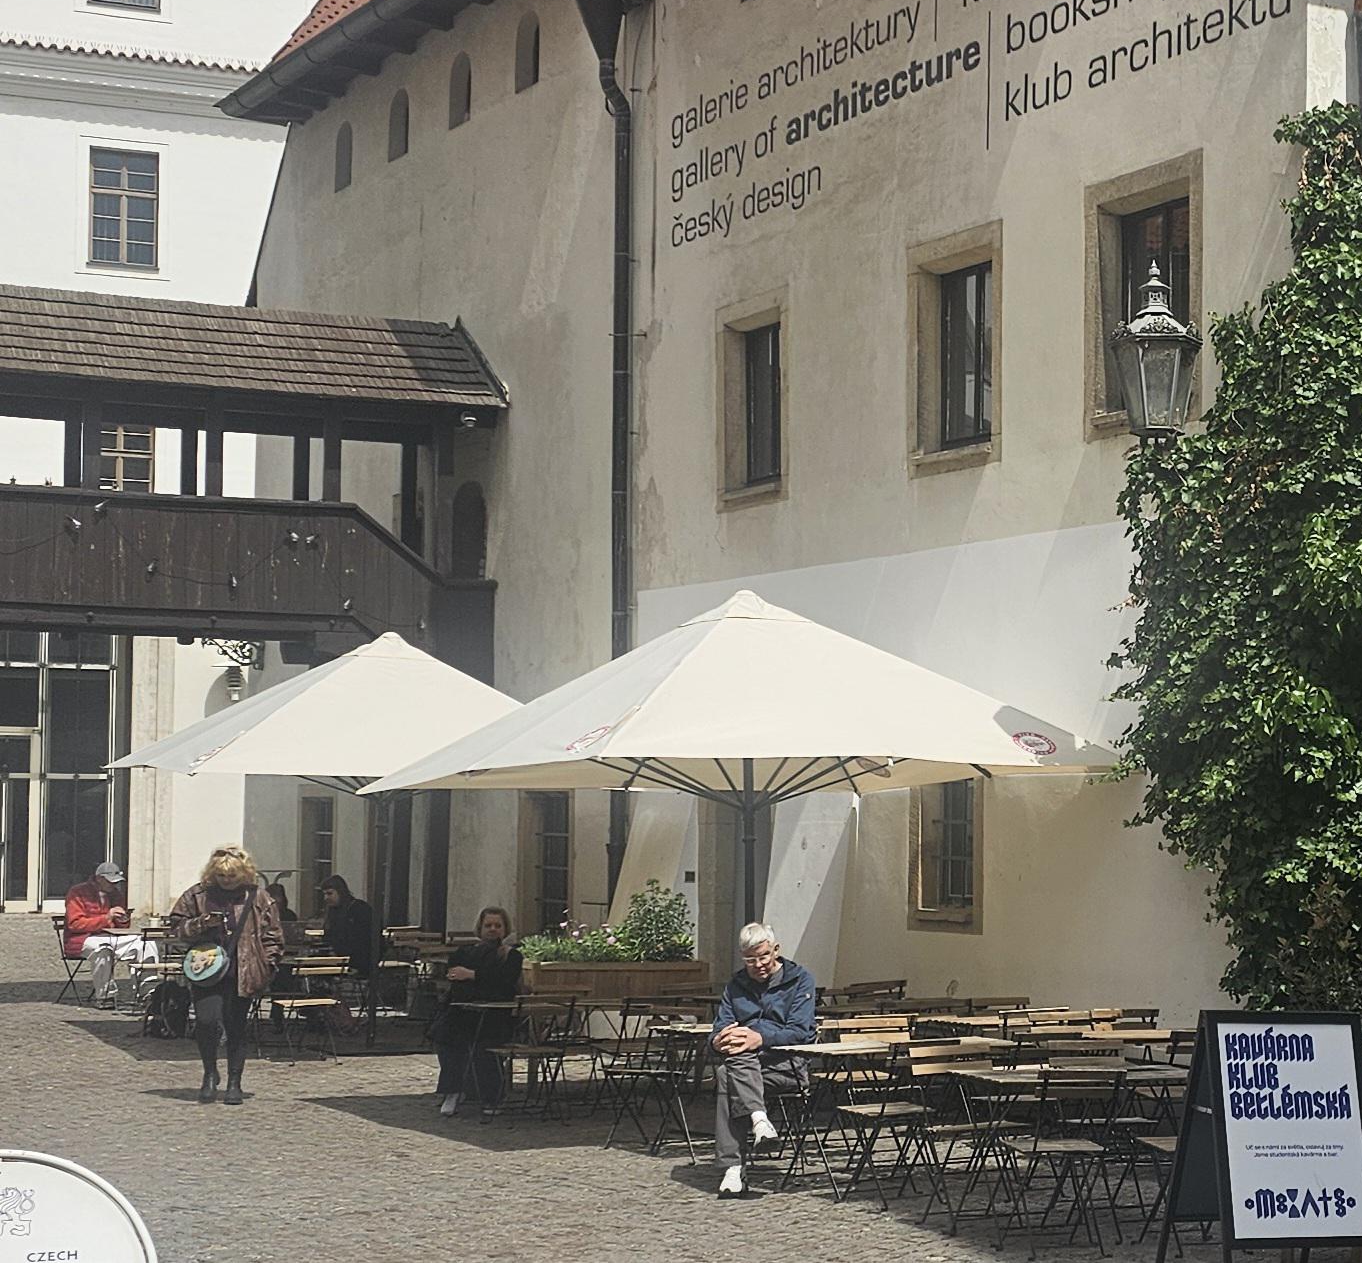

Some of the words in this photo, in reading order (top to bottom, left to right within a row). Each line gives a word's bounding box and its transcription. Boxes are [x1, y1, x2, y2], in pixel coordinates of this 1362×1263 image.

[671, 79, 749, 149] galerie
[757, 0, 921, 101] architektury
[1005, 61, 1072, 121] klub
[671, 139, 747, 204] gallery
[754, 114, 778, 158] of
[784, 40, 981, 146] architecture
[671, 193, 734, 248] český
[742, 165, 822, 221] design
[1224, 1026, 1315, 1062] KAVÁRNA
[1227, 1062, 1279, 1091] KLUB
[26, 1250, 79, 1263] CZECH
